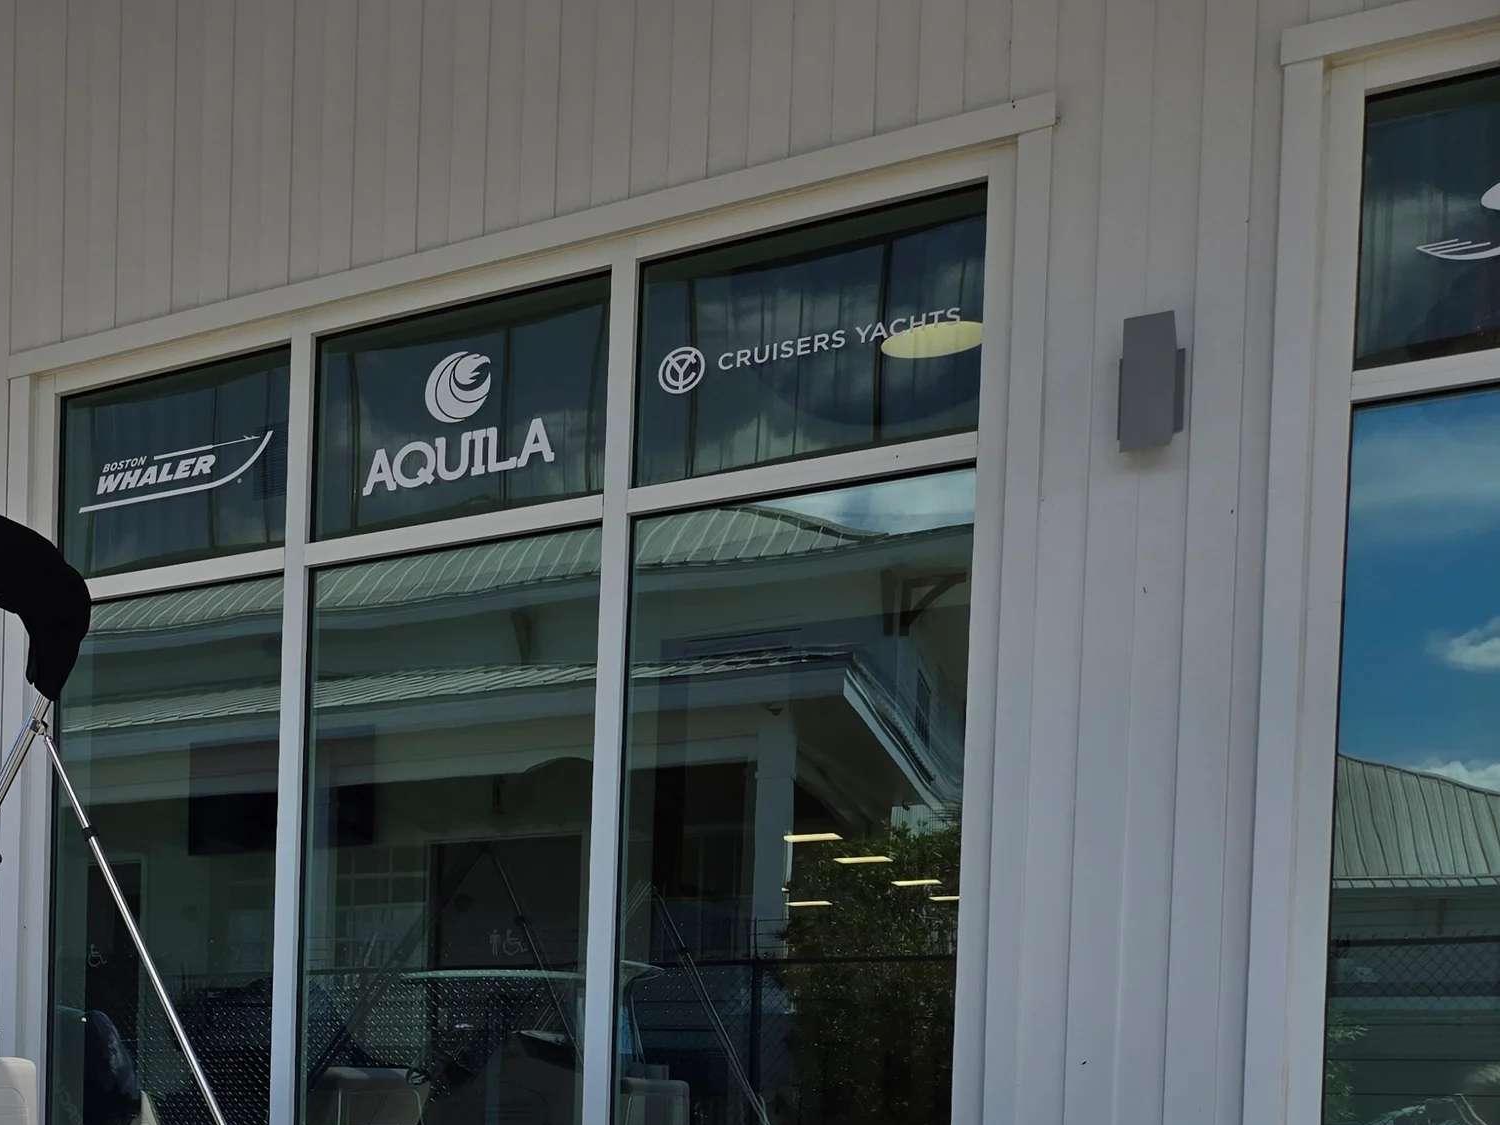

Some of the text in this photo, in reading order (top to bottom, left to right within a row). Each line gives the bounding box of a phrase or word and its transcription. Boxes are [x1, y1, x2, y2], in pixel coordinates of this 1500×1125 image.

[717, 306, 962, 371] CRUISERS YACHTS
[96, 454, 217, 496] WHALER
[102, 455, 148, 473] BOSTON
[362, 417, 556, 497] AQUILA
